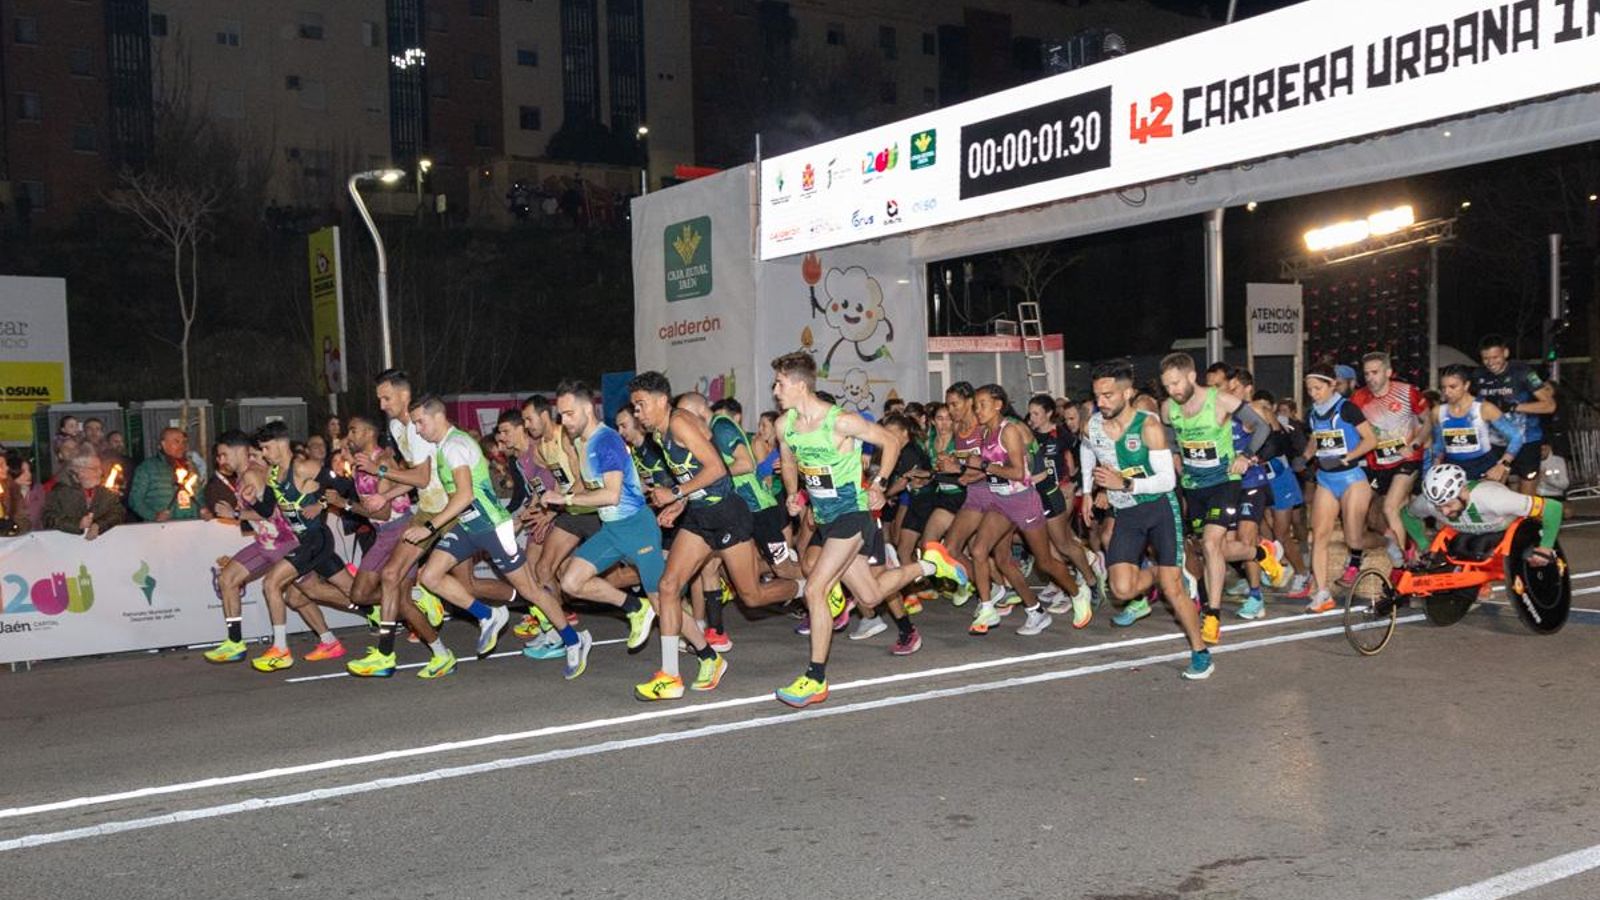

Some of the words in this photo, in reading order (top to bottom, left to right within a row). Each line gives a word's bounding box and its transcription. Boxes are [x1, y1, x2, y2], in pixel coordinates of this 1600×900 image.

[1130, 92, 1174, 145] 42
[1182, 45, 1354, 134] CARRERA
[1367, 0, 1539, 88] URBANA
[968, 110, 1101, 180] 00:00:01.30
[1251, 304, 1300, 320] ATENCIÓN
[1258, 322, 1295, 334] MEDIOS
[5, 386, 50, 397] OSUNA
[1320, 437, 1335, 448] 46
[1452, 436, 1468, 444] 45
[1190, 448, 1206, 458] 54
[804, 474, 822, 486] 58
